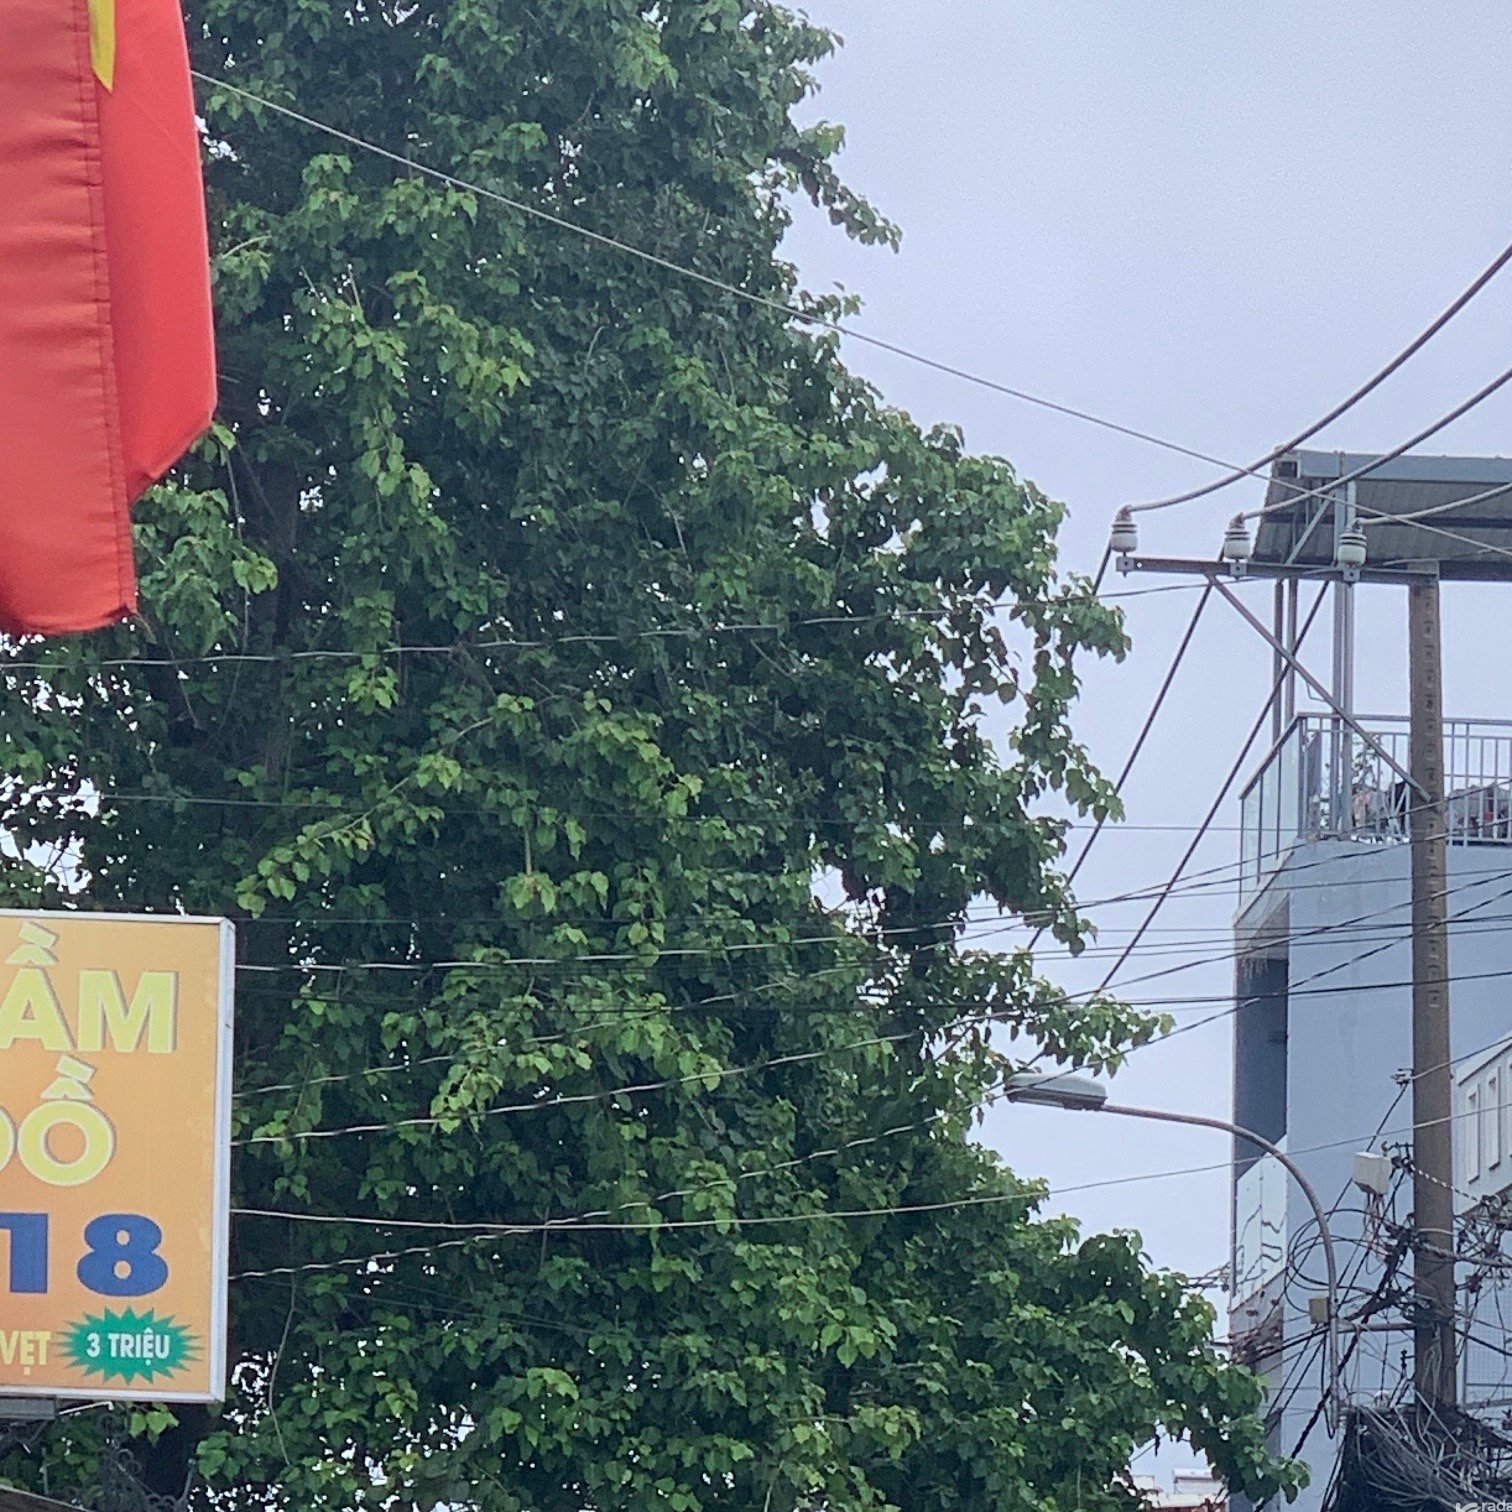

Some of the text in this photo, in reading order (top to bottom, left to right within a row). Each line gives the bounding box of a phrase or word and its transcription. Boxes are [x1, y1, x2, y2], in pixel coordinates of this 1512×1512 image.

[0, 1055, 115, 1187] Ồ
[86, 1331, 171, 1366] 3 TRIỆU
